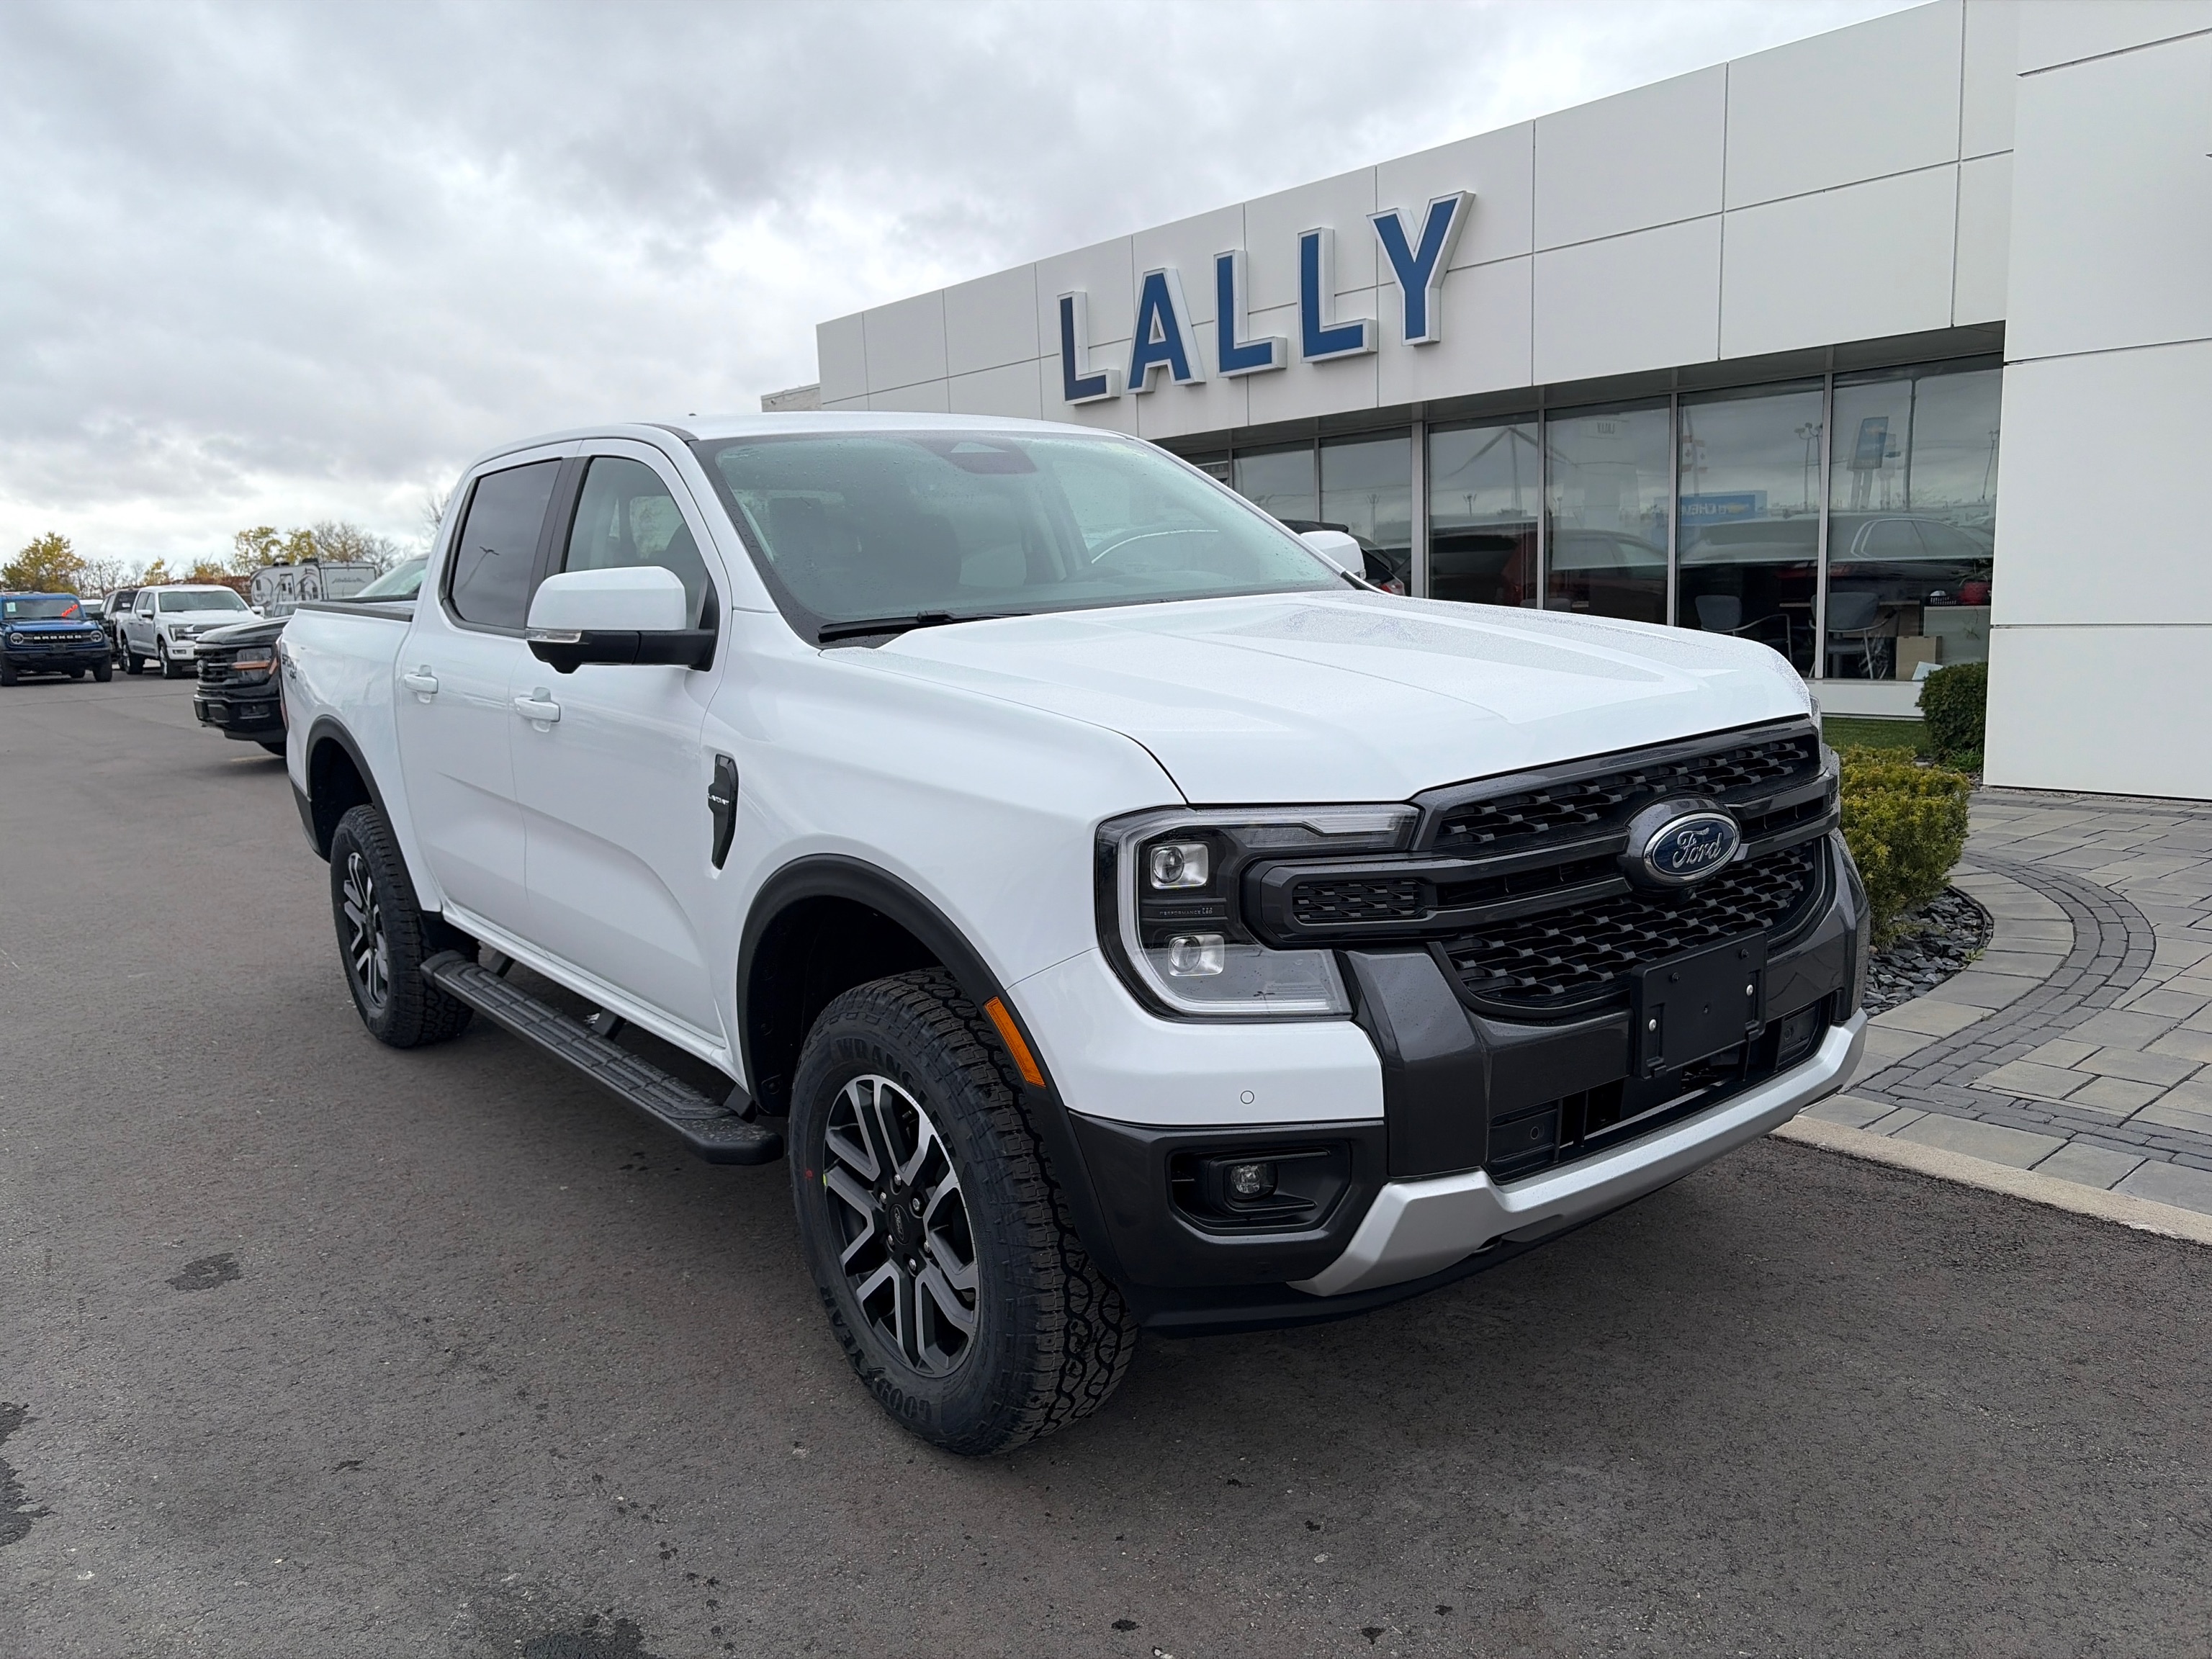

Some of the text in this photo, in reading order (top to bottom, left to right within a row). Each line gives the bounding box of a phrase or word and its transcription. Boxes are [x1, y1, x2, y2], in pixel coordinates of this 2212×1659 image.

[1057, 190, 1476, 405] LALLY
[1672, 827, 1722, 868] Ford
[835, 1038, 958, 1158] WRANGLER
[819, 1286, 932, 1423] GOODYEAR
